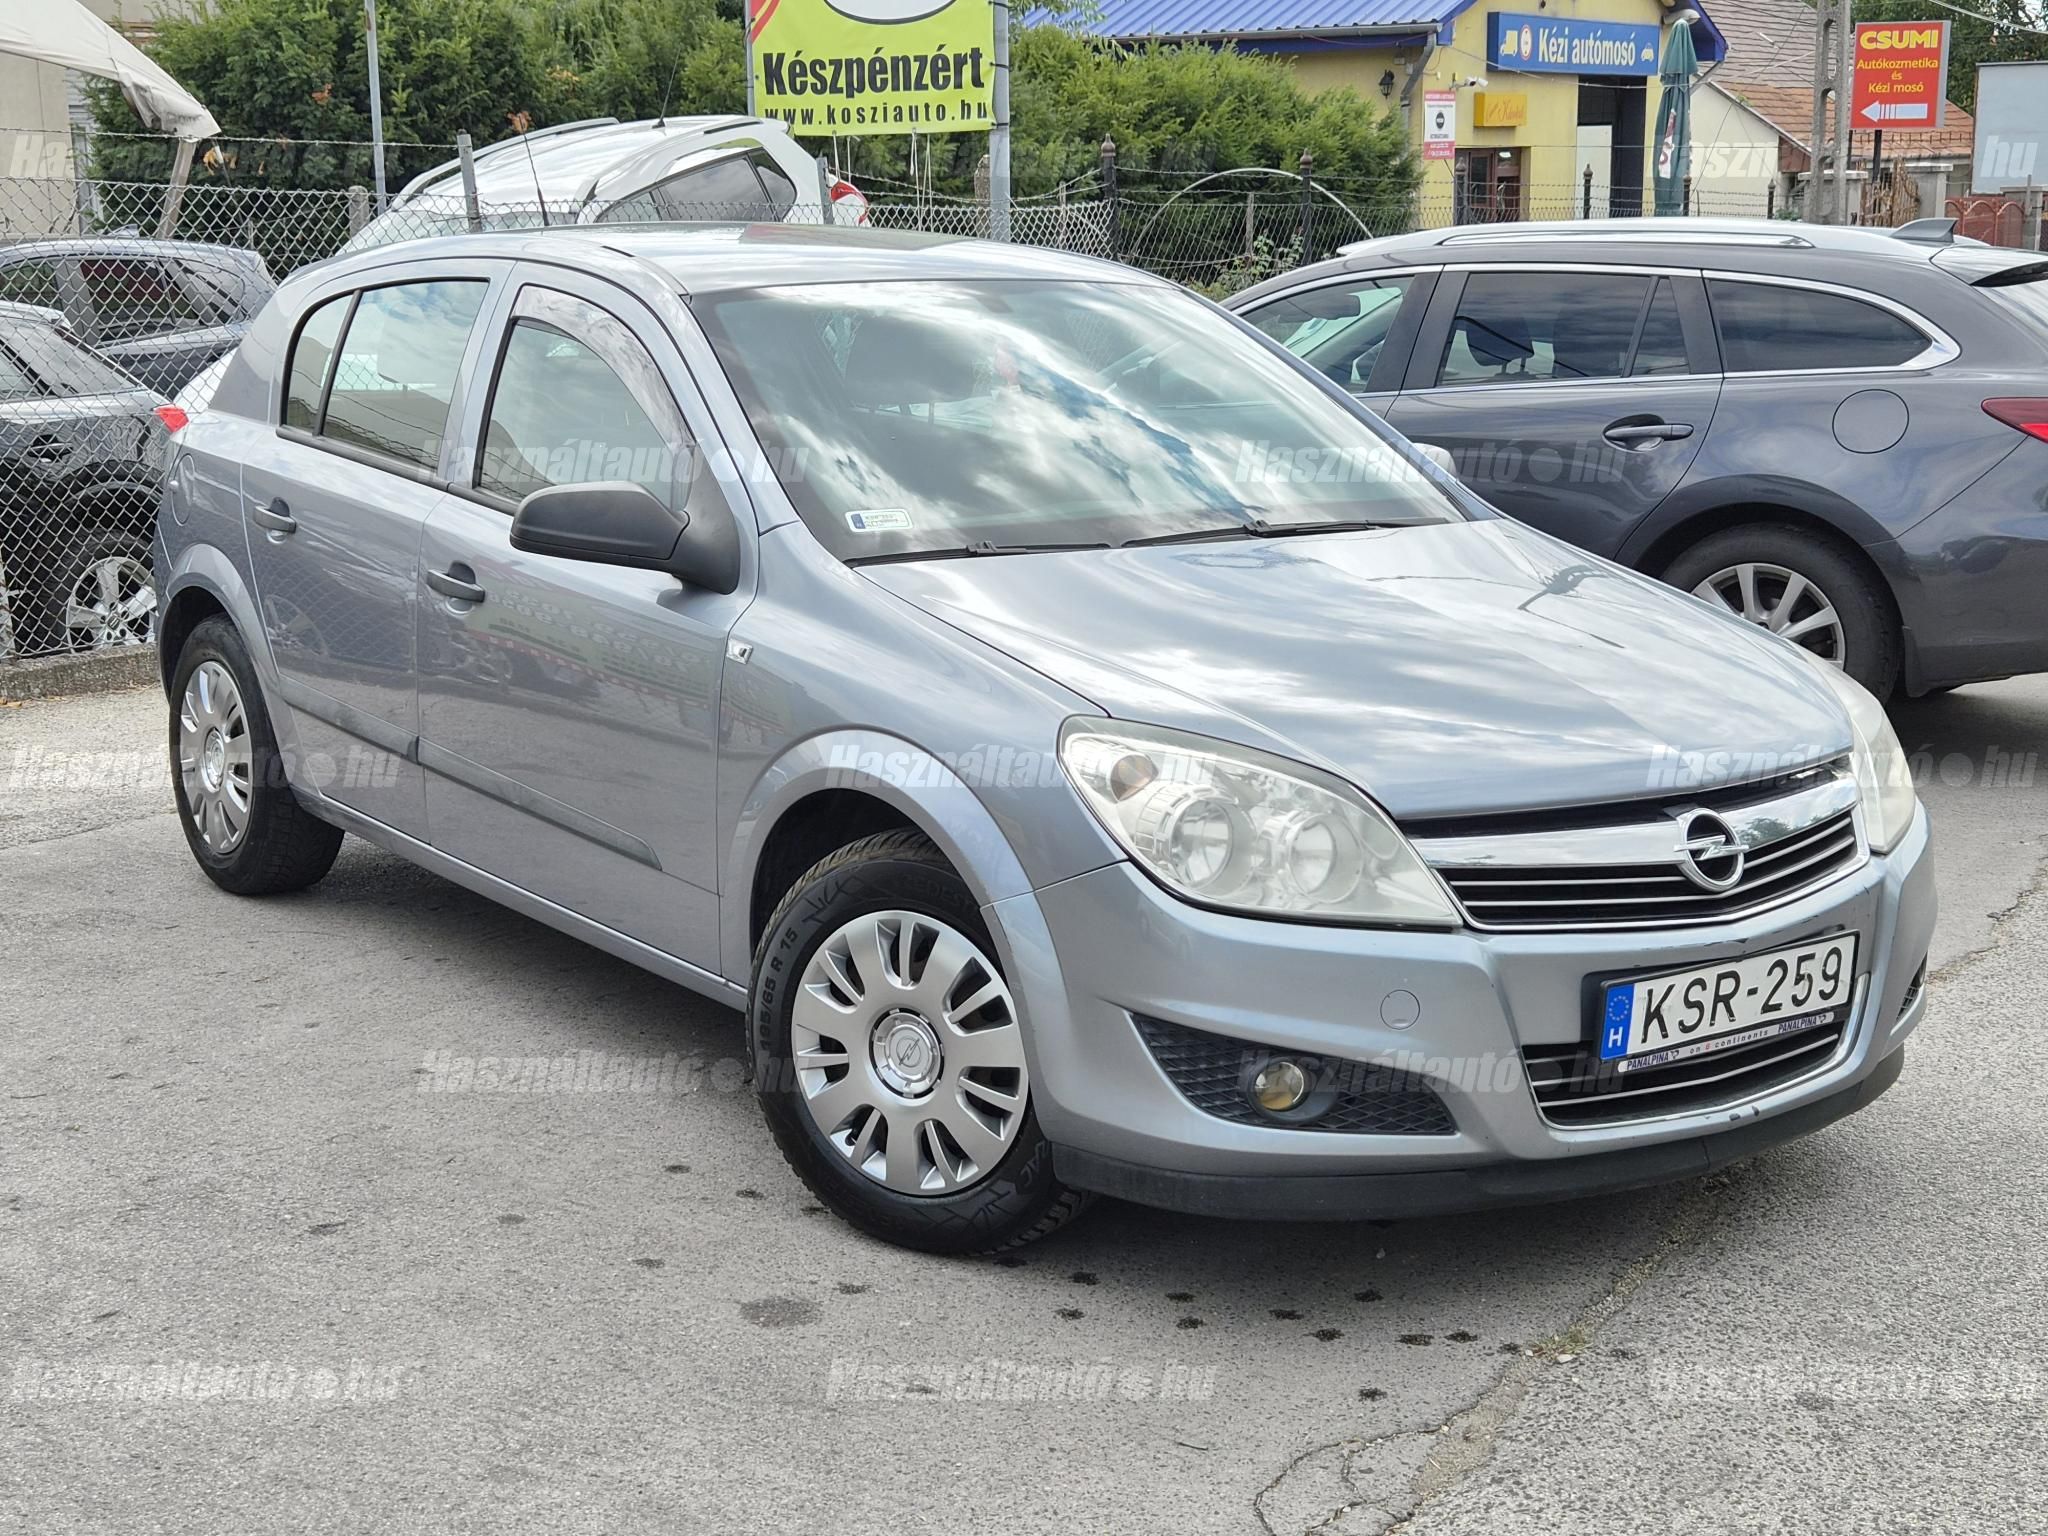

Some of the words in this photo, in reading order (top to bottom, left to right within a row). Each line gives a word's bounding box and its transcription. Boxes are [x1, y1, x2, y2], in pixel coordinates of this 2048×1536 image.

[1538, 26, 1569, 64] Kézi
[1571, 31, 1637, 66] autómosó
[1859, 29, 1939, 50] CSUMI
[762, 43, 986, 99] Készpénzért
[1856, 57, 1939, 71] Autókozmetika
[1891, 70, 1903, 81] és
[1868, 81, 1890, 94] Kézi
[1893, 81, 1925, 93] mosó
[764, 99, 988, 125] www.kosziauto.hu
[1640, 946, 1843, 1044] KSR-259
[1607, 1026, 1624, 1049] H
[1626, 1050, 1669, 1070] PANALPINA
[1714, 1028, 1769, 1049] continents
[1777, 1017, 1818, 1034] PANALPINA
